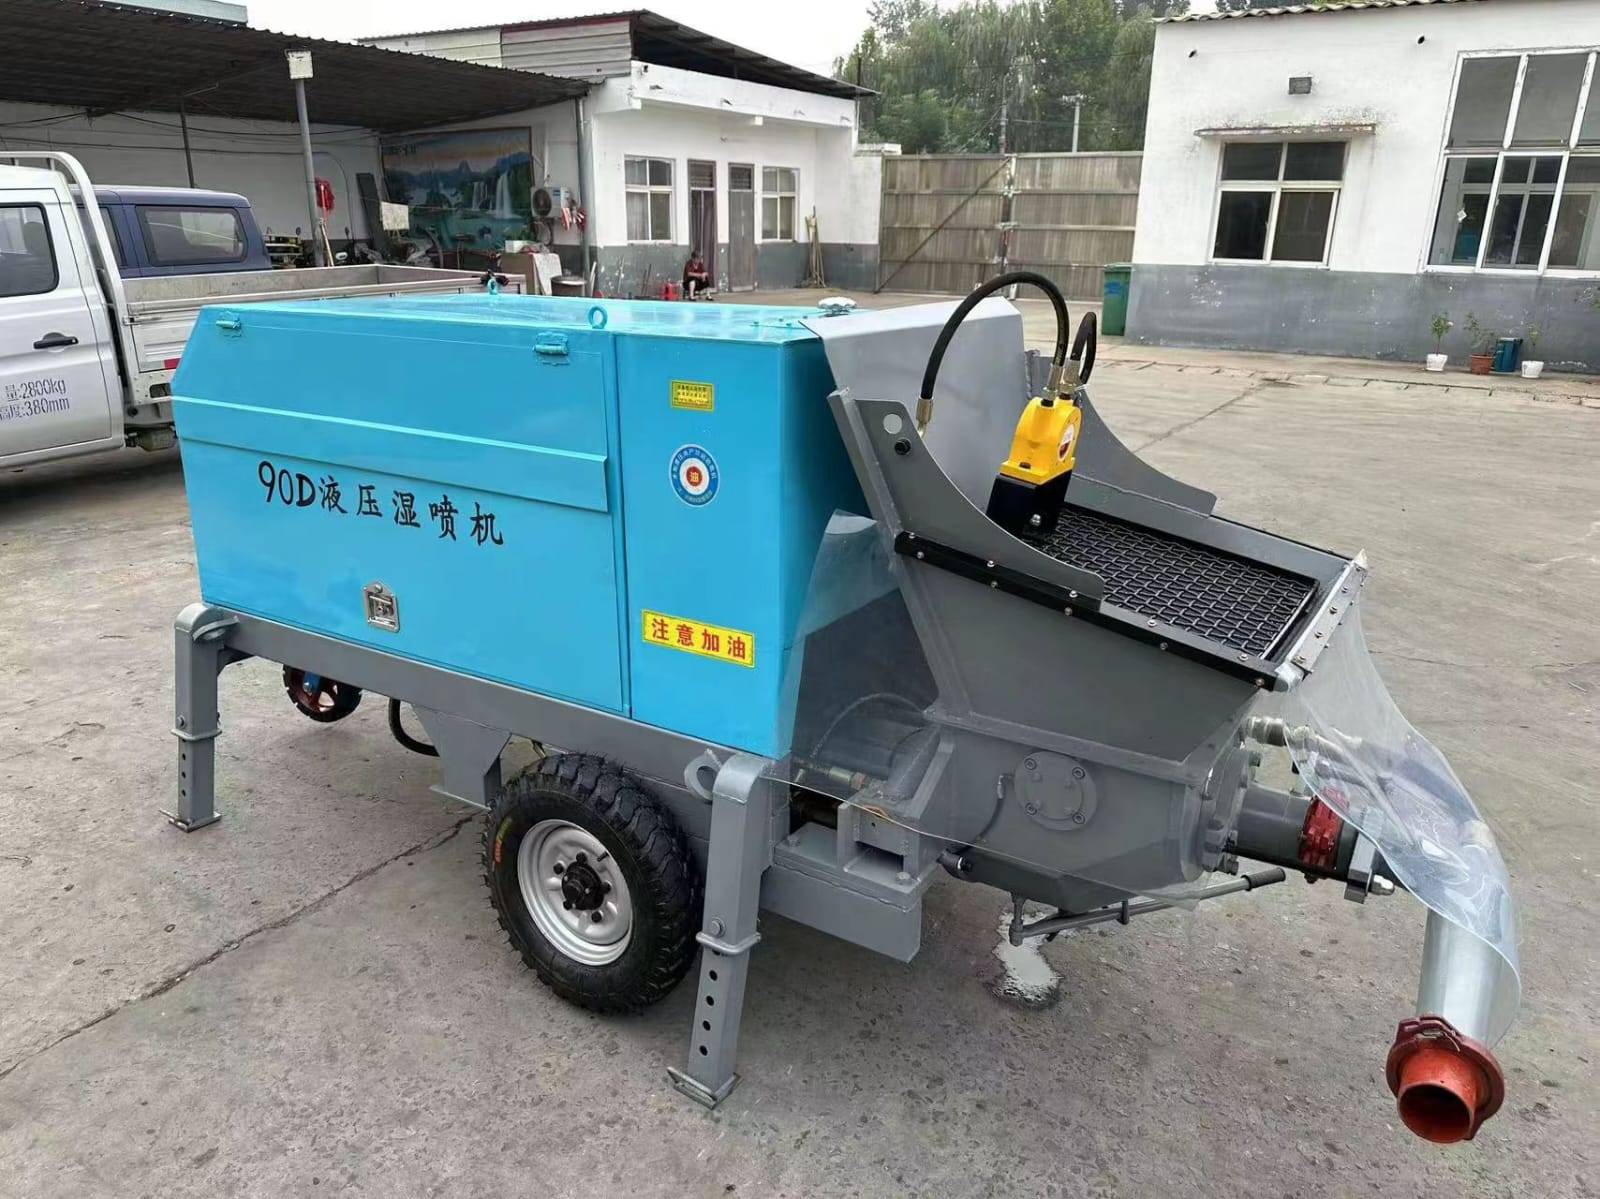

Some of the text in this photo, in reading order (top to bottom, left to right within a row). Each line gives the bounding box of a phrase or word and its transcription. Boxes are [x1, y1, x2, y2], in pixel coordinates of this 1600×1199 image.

[258, 460, 504, 546] 90D液压湿喷机
[651, 617, 746, 660] 注意加油
